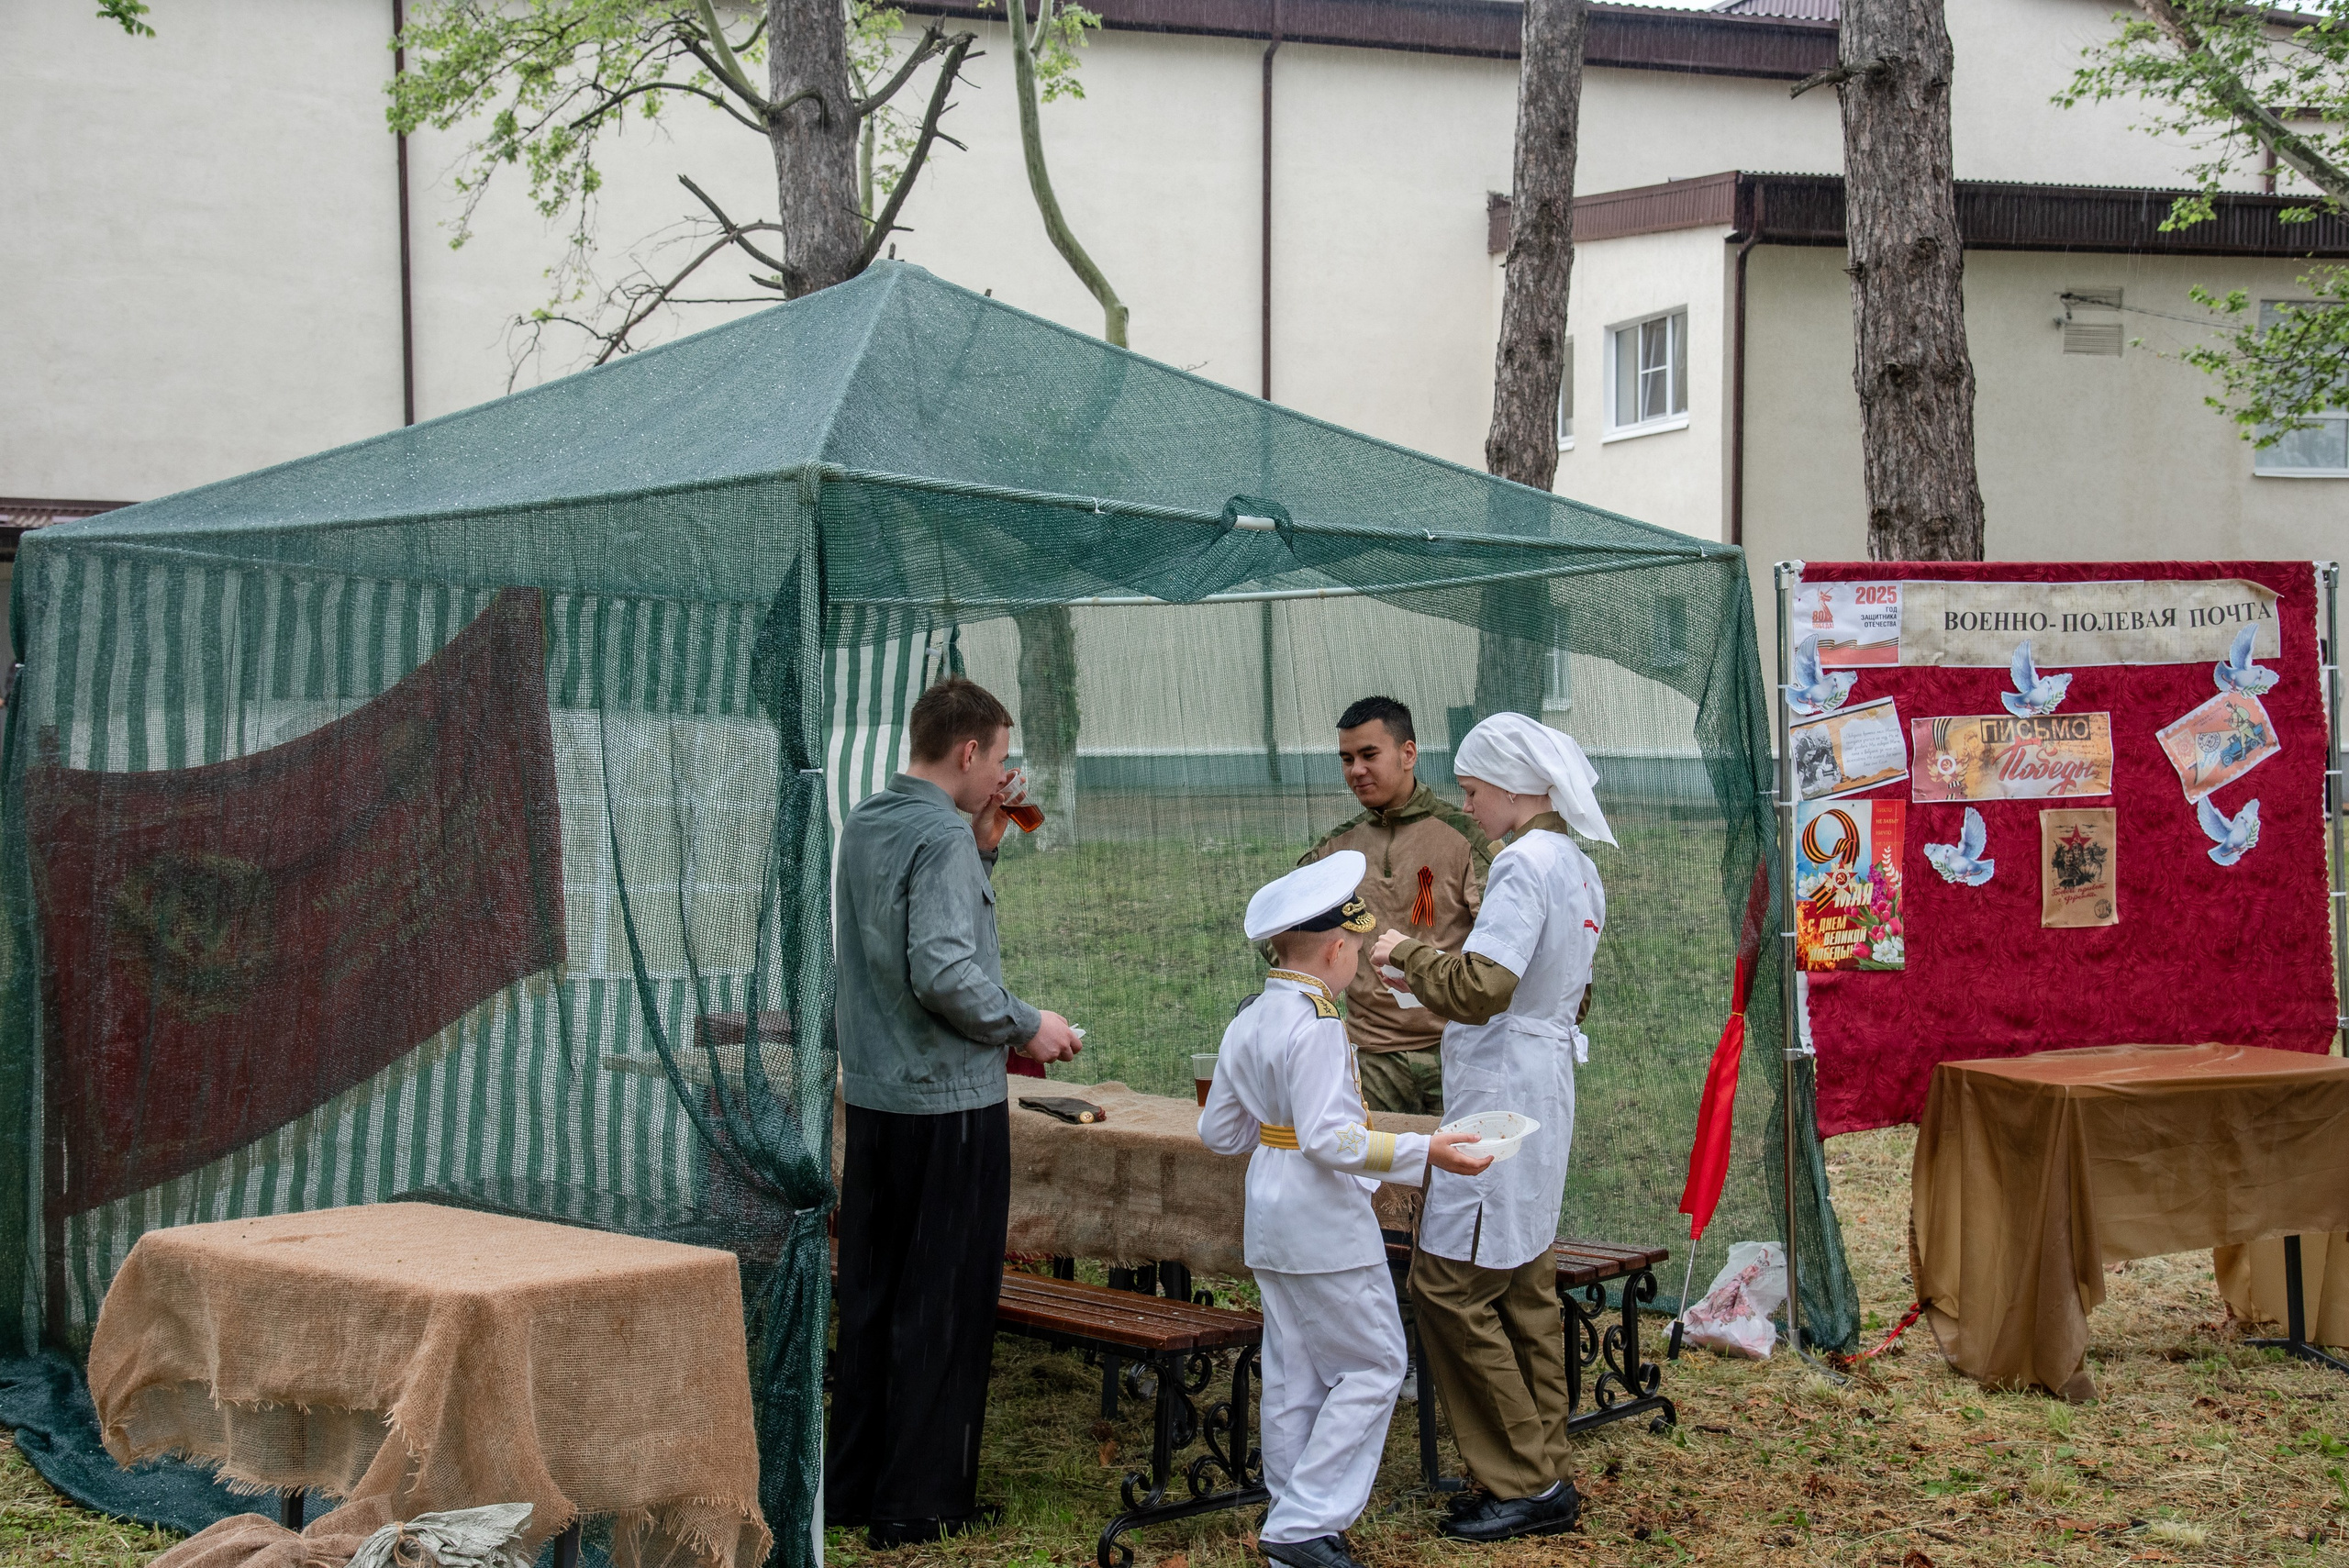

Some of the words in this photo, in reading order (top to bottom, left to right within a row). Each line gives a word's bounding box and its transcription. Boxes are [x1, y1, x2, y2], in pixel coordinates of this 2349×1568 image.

[1855, 585, 1897, 605] 2025
[1812, 610, 1824, 621] 80
[2062, 608, 2176, 632] ПОЛЕВАЯ
[2189, 601, 2272, 628] ПОЧТА
[1980, 718, 2090, 742] ПИСЬМО
[1992, 737, 2096, 796] Победы
[1834, 883, 1874, 908] МАЯ
[1808, 918, 1815, 933] С
[1819, 916, 1847, 934] ДНЕМ
[1824, 926, 1867, 946] ВЕЛИКОЙ
[1809, 945, 1854, 962] ПОБЕДЫ!
